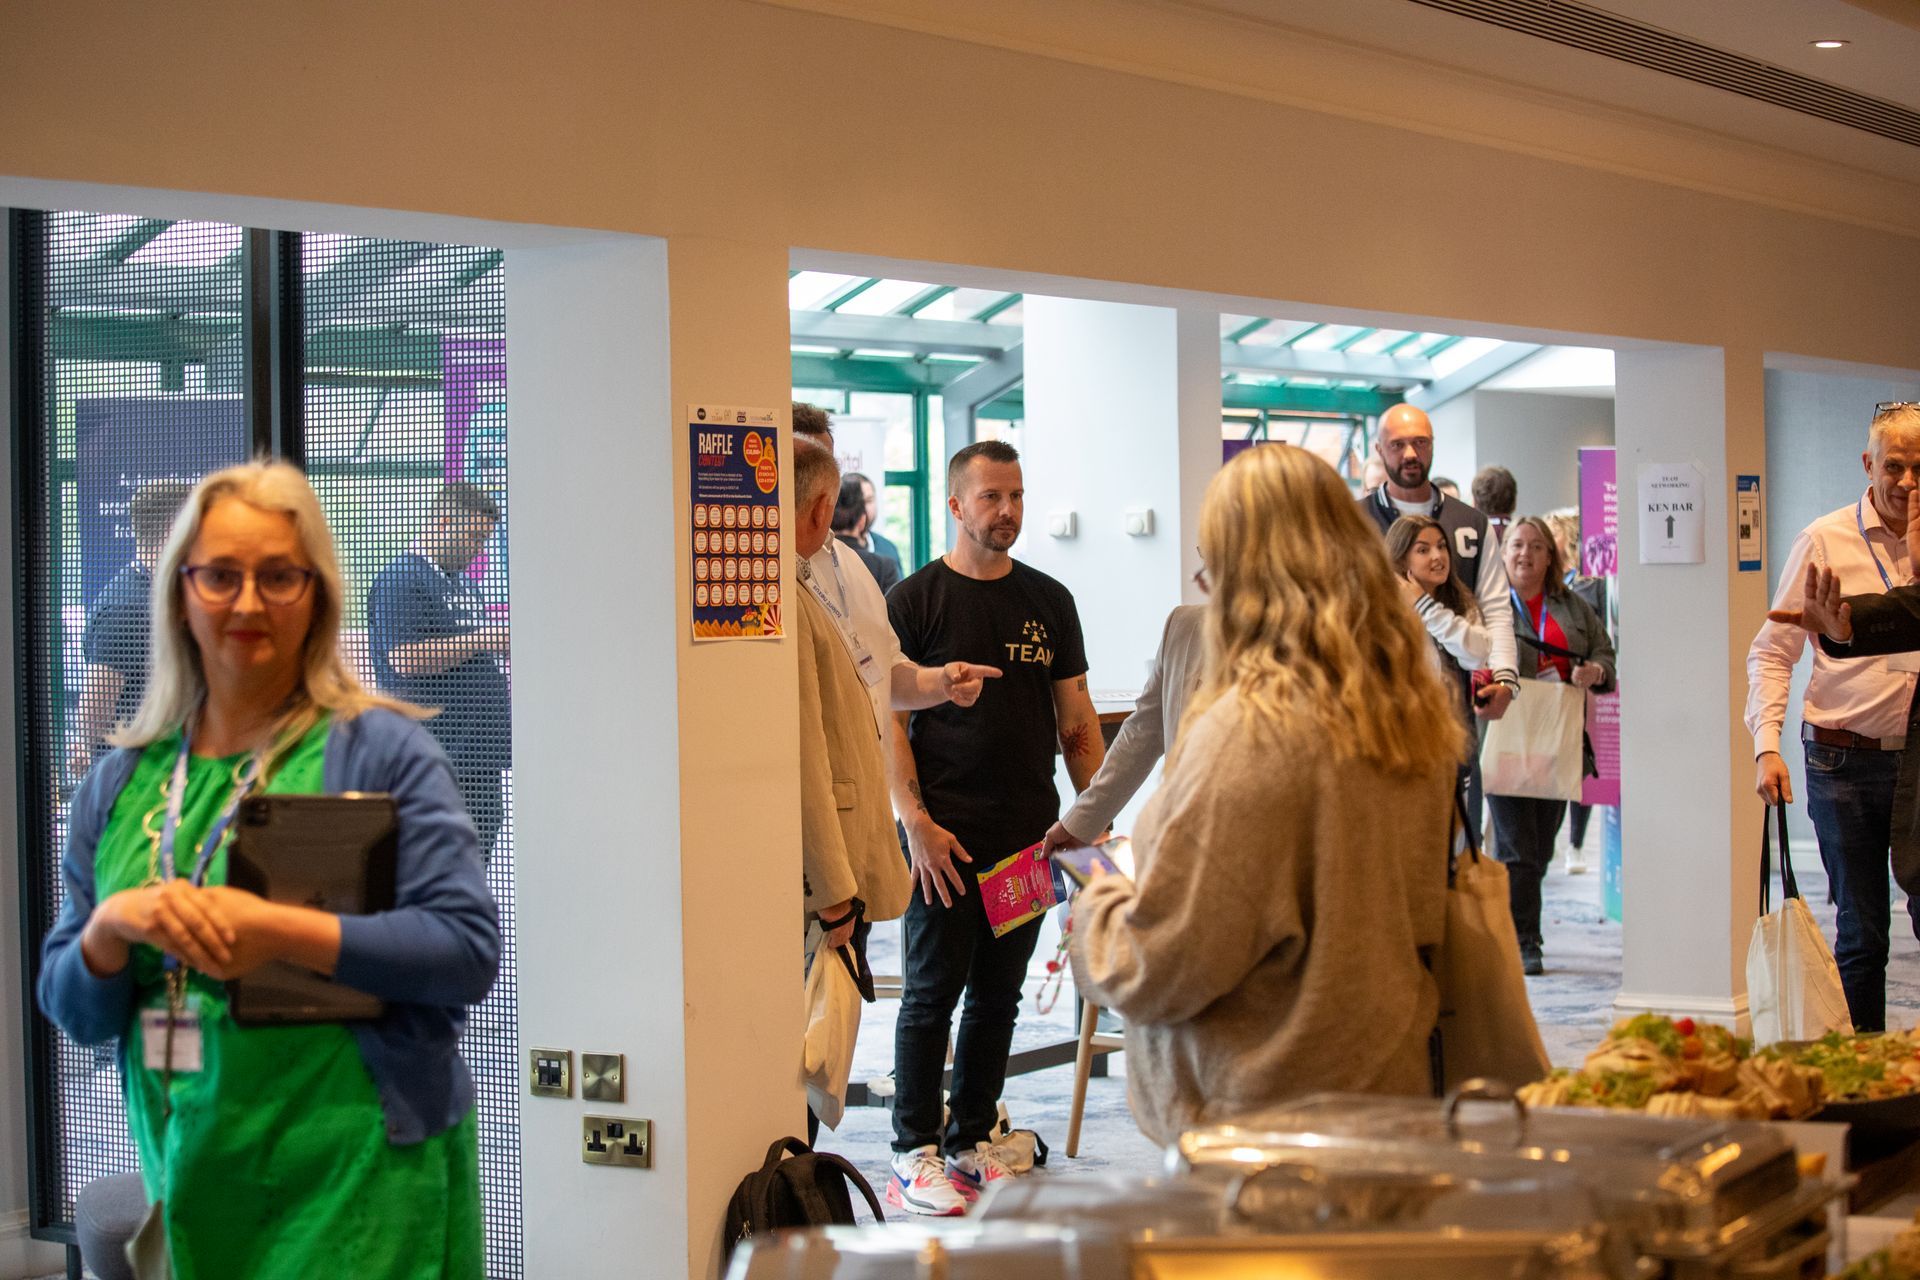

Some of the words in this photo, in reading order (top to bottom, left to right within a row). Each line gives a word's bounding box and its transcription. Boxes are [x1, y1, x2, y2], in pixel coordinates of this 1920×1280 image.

[698, 432, 733, 455] RAFFLE
[1648, 502, 1669, 513] KEN
[1672, 502, 1693, 513] BAR
[1454, 526, 1478, 558] C
[812, 585, 828, 603] nexus
[827, 601, 842, 618] talent
[1005, 877, 1018, 908] TEAM
